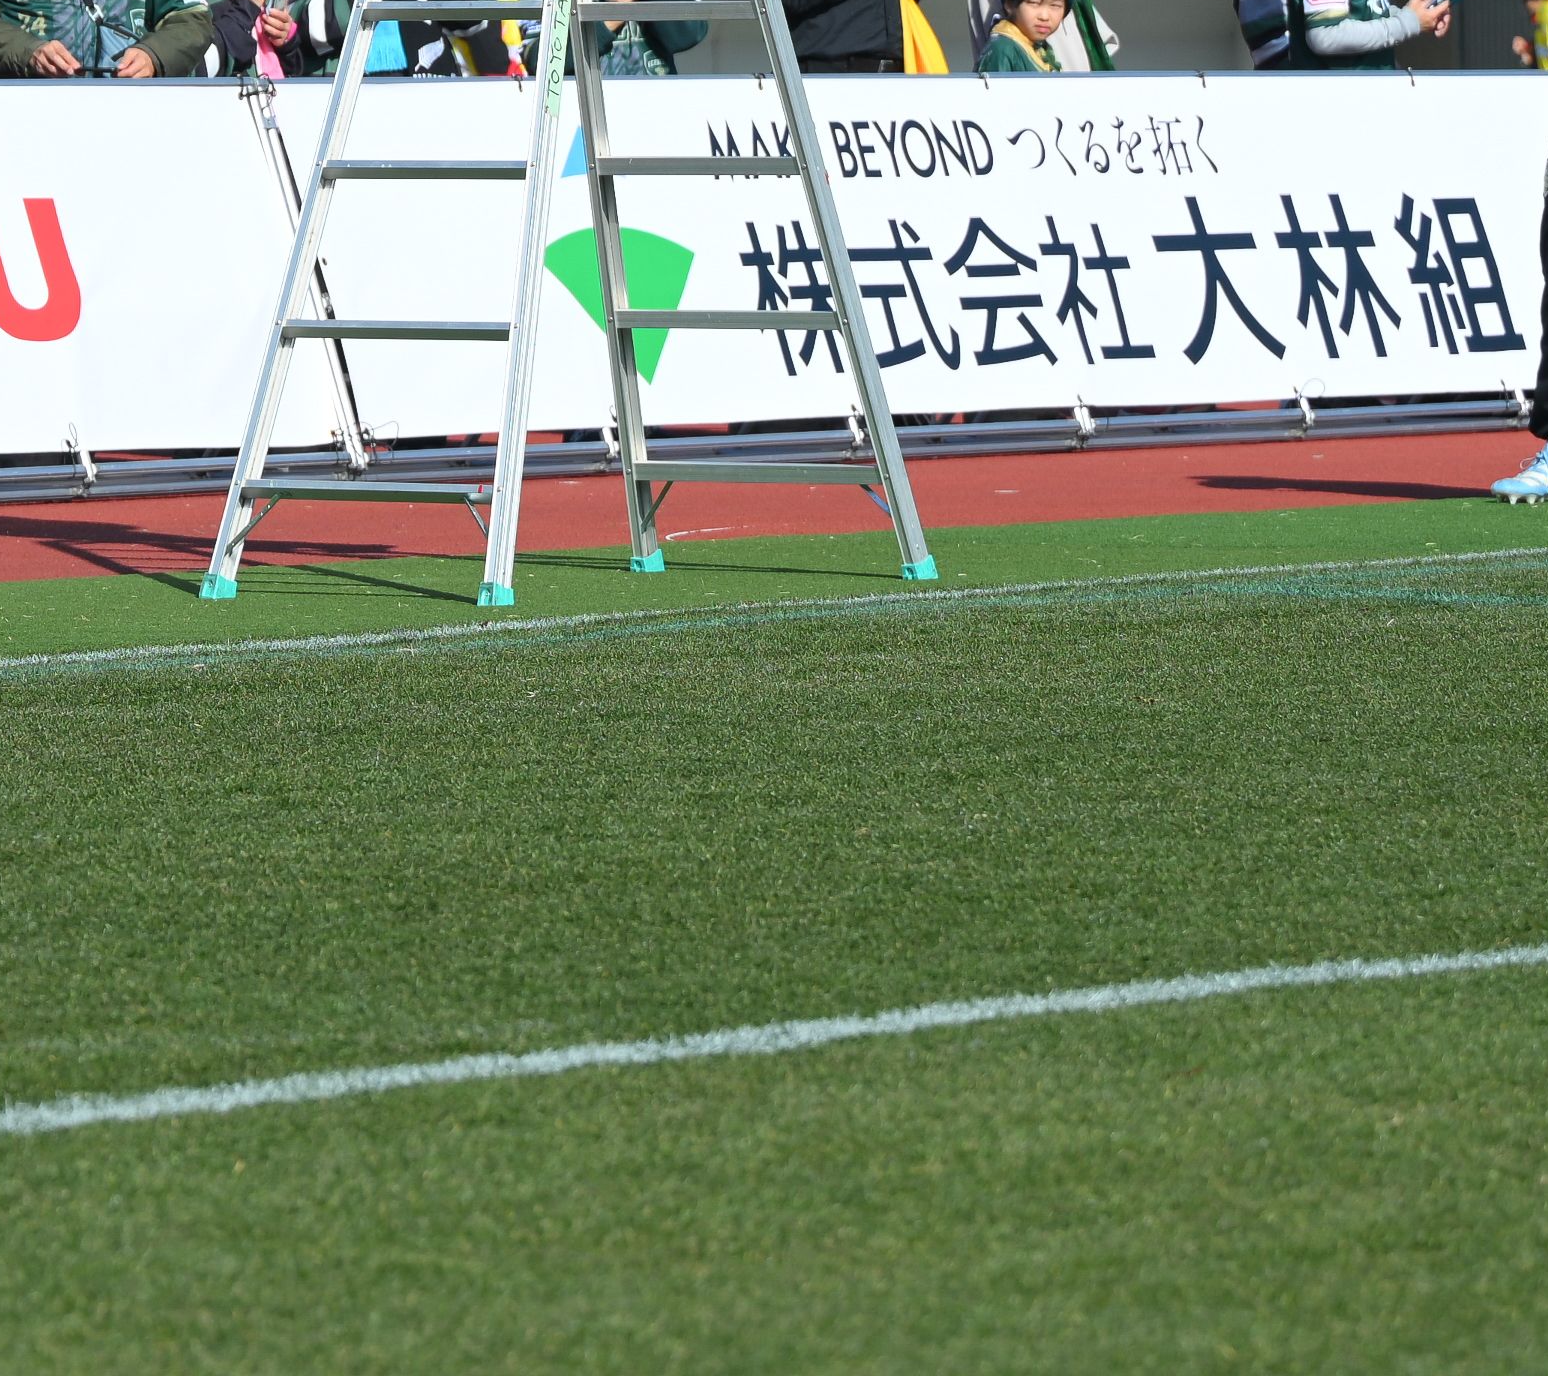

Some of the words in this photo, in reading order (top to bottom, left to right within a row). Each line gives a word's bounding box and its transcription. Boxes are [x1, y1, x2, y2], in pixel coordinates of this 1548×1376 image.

[829, 120, 993, 178] BEYOND
[1008, 115, 1218, 177] つくるを拓く
[739, 194, 1526, 377] 株式会社大林組
